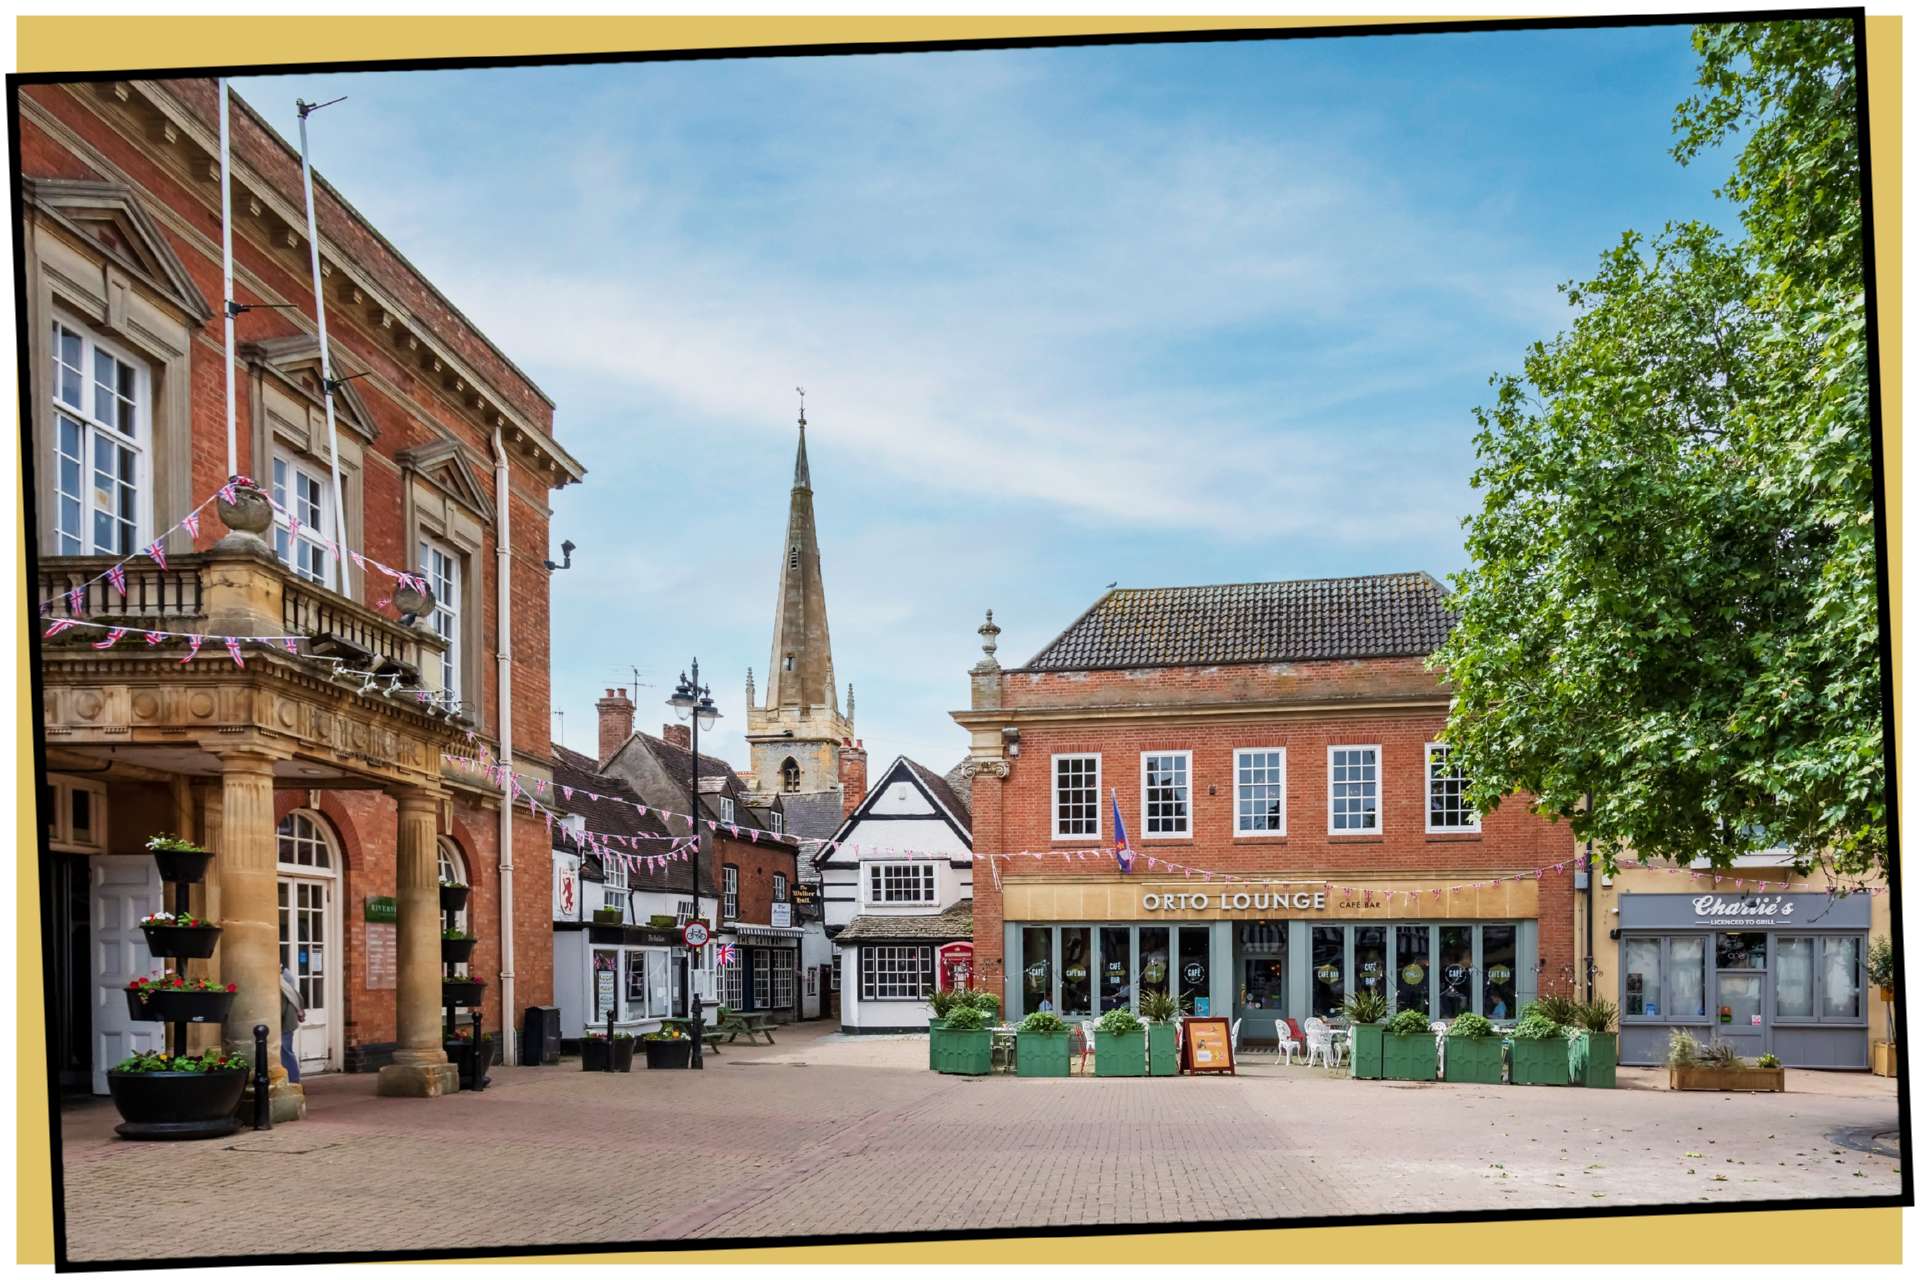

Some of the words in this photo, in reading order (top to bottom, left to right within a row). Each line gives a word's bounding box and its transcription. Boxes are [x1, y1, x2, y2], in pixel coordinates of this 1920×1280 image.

[1143, 893, 1208, 910] ORTO
[1221, 892, 1325, 910] LOUNGE
[1364, 901, 1380, 909] BAR
[1693, 895, 1793, 916] Charlie's
[1187, 967, 1201, 977] CAFÉ
